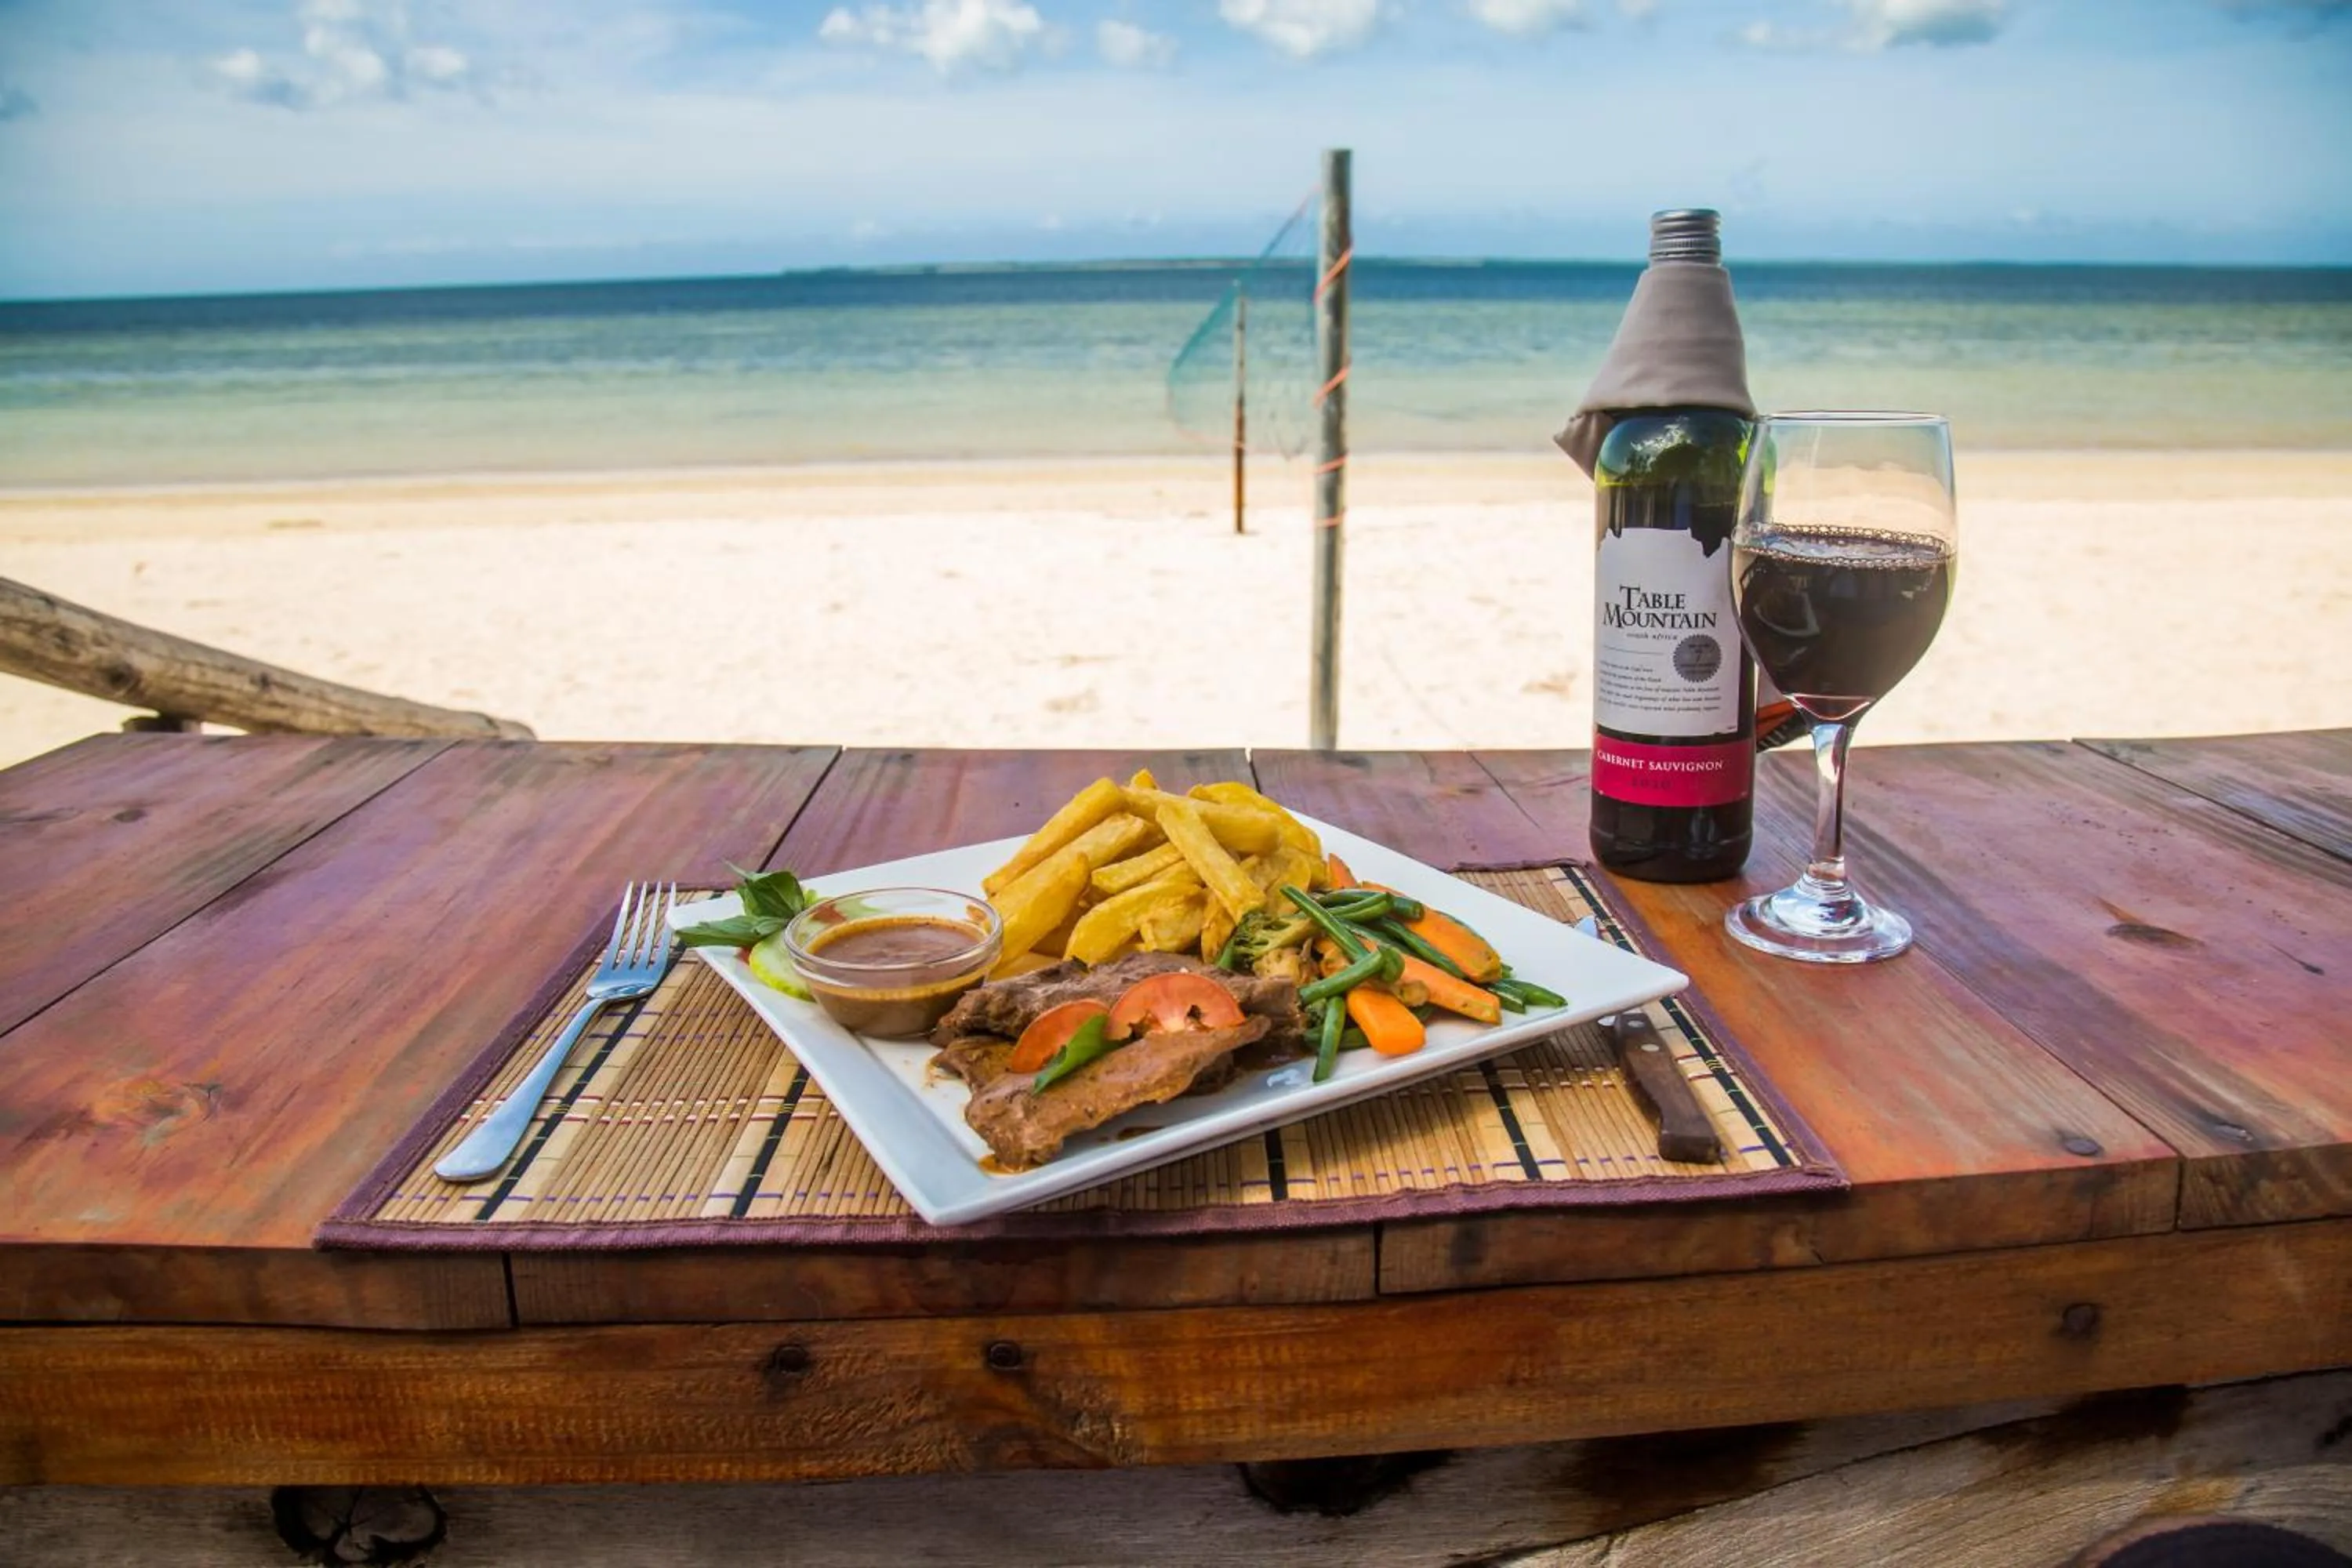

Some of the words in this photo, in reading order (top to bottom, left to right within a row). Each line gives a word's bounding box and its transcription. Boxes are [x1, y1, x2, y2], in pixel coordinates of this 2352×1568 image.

[1620, 585, 1686, 610] TABLE
[1603, 602, 1717, 628] MOUNTAIN
[1597, 750, 1645, 769] CABERNET
[1649, 760, 1724, 771] SAUVIGNON
